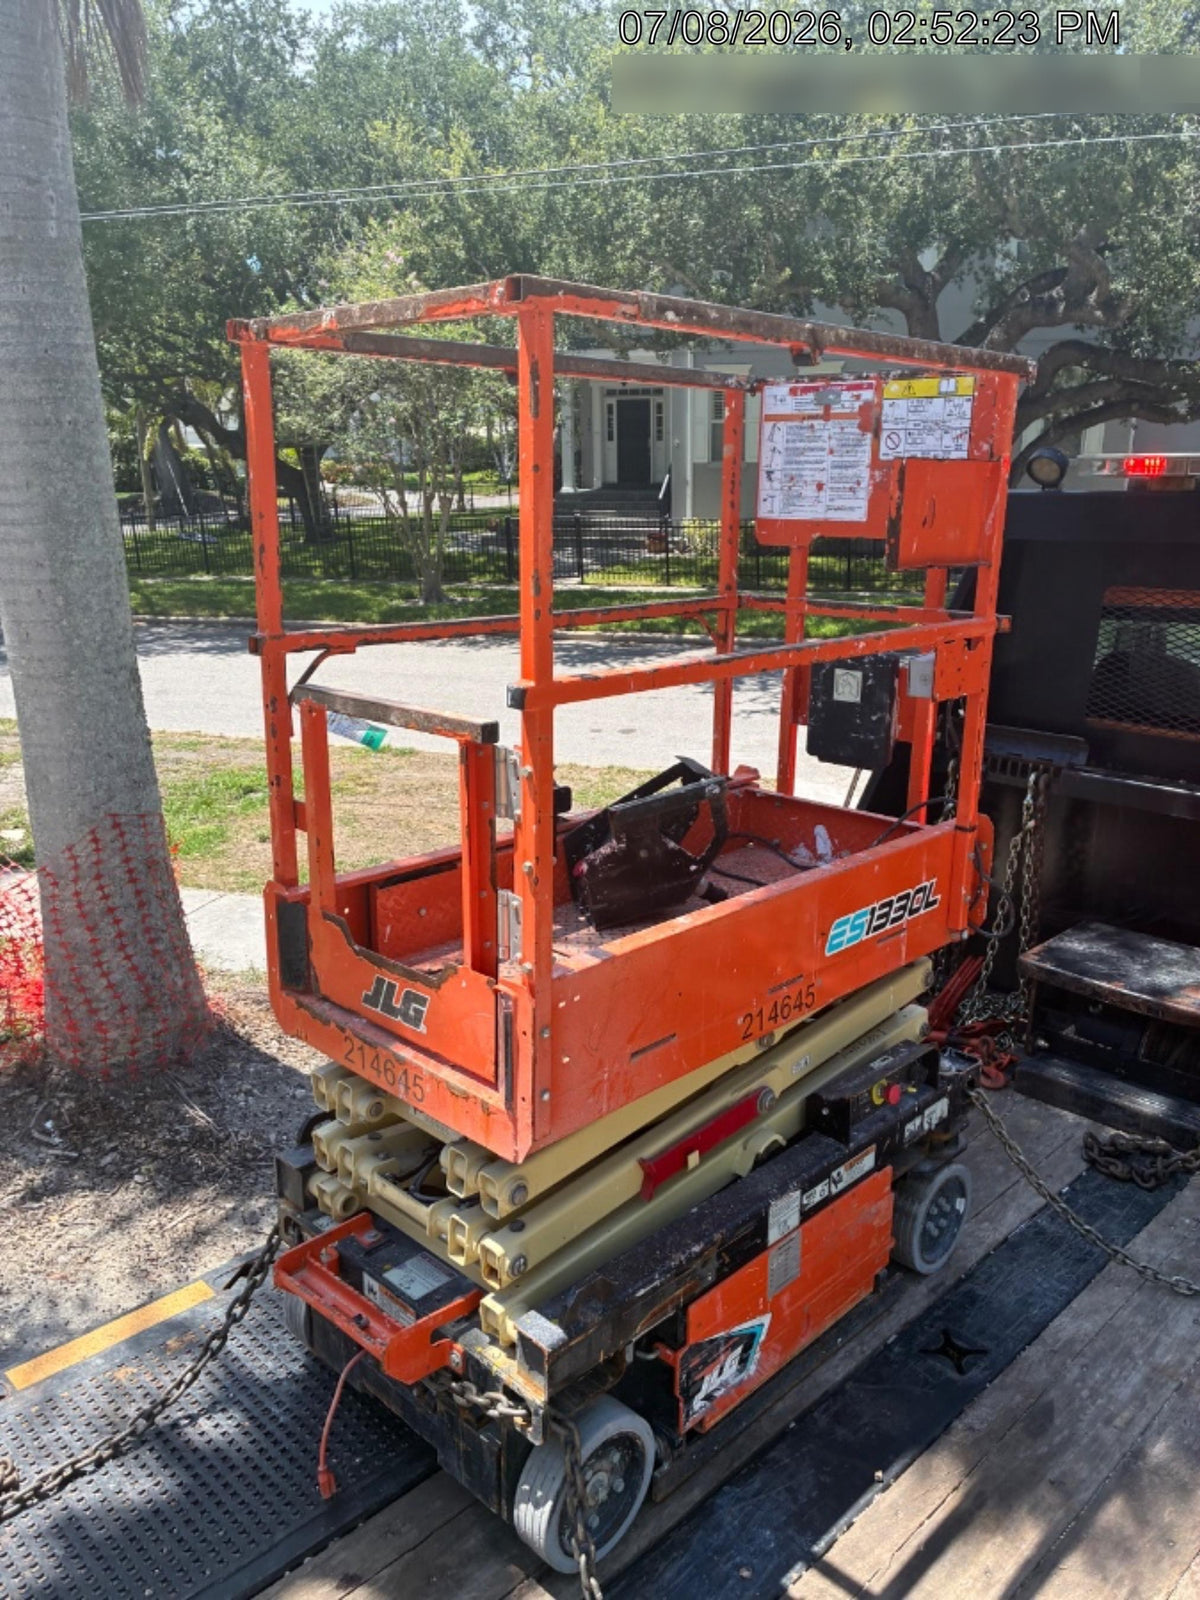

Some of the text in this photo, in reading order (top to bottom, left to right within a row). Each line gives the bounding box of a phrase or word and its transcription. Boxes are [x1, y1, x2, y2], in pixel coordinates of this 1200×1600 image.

[826, 878, 941, 956] ES1330L
[361, 974, 430, 1034] JLG
[742, 984, 816, 1041] 214645
[344, 1036, 424, 1104] 214645
